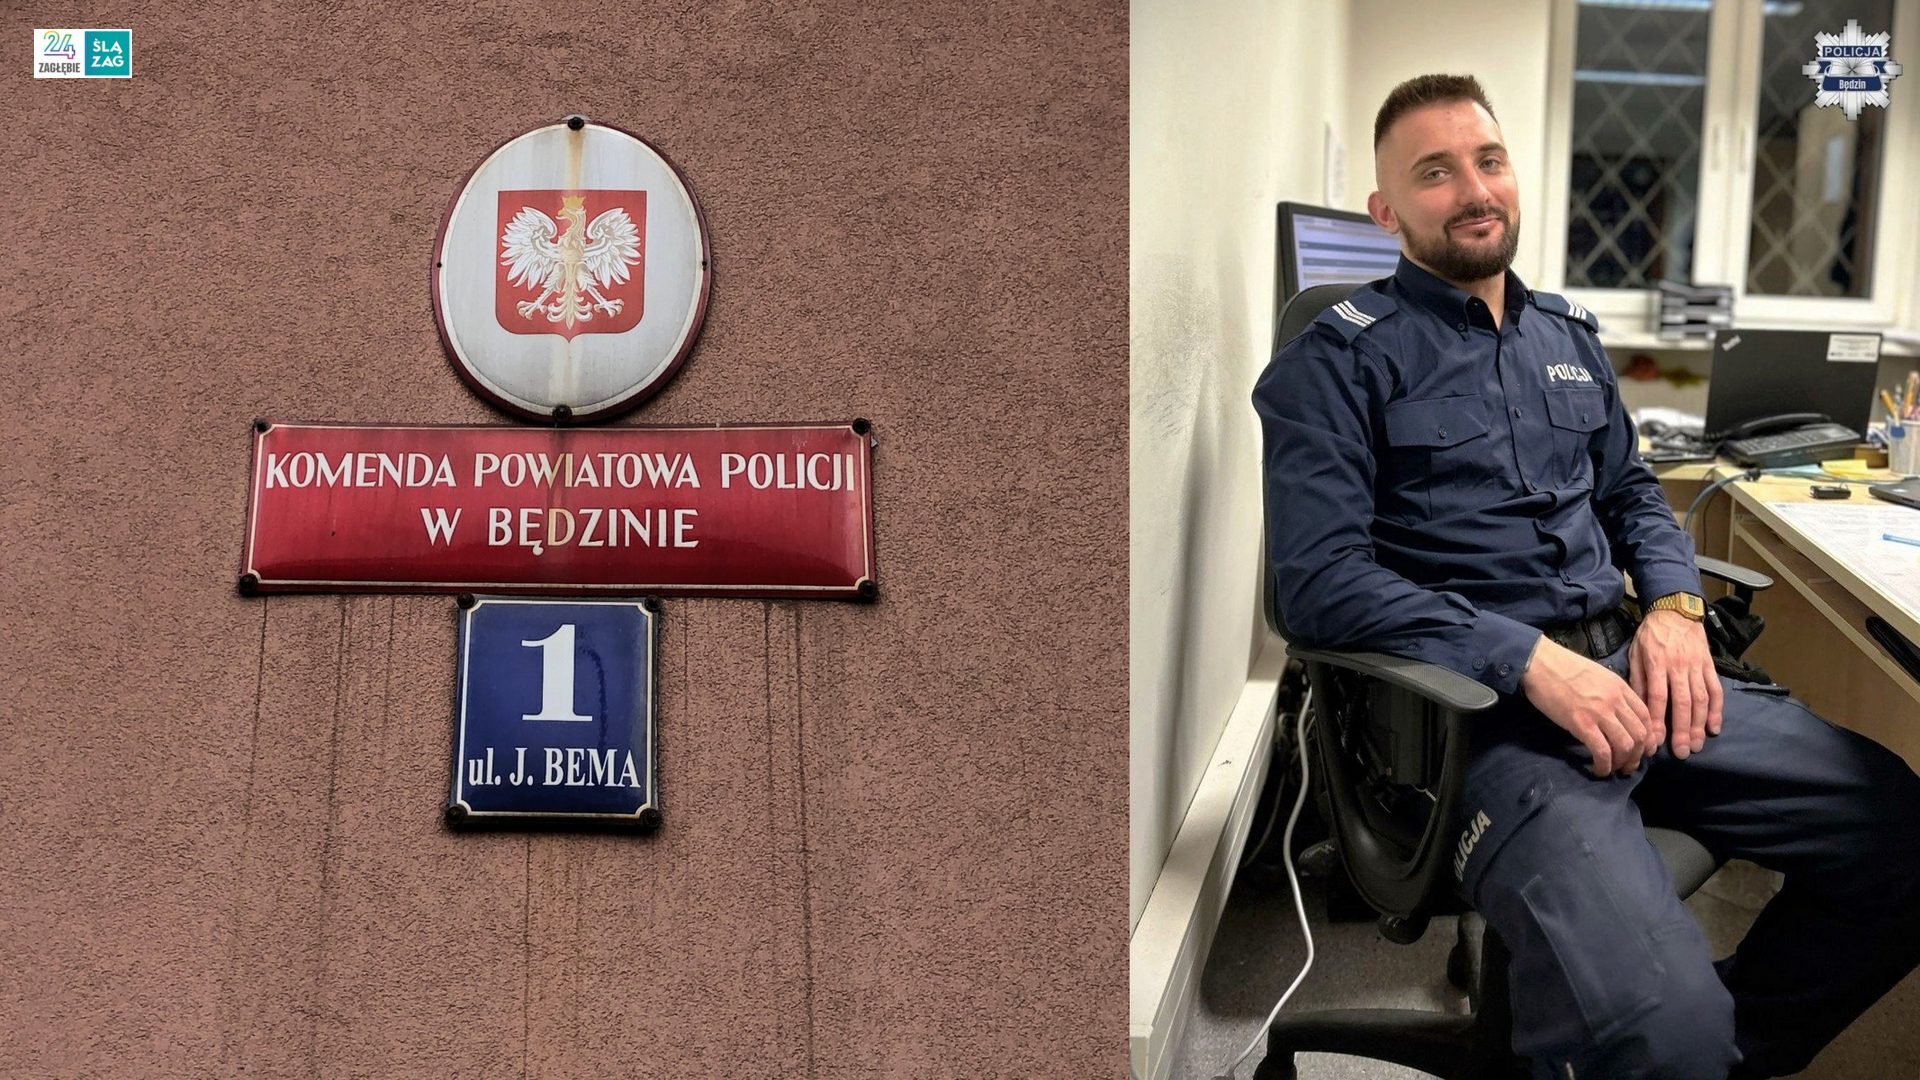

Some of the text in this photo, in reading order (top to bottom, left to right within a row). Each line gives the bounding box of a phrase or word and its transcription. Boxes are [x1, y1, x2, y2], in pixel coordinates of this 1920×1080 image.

[265, 452, 854, 491] KOMENDA POWIATOWA POLICJI
[420, 508, 699, 555] W BĘDZINIE
[521, 624, 593, 721] 1
[468, 747, 641, 788] ul. J. BEMA
[1453, 809, 1492, 882] OLICJA
